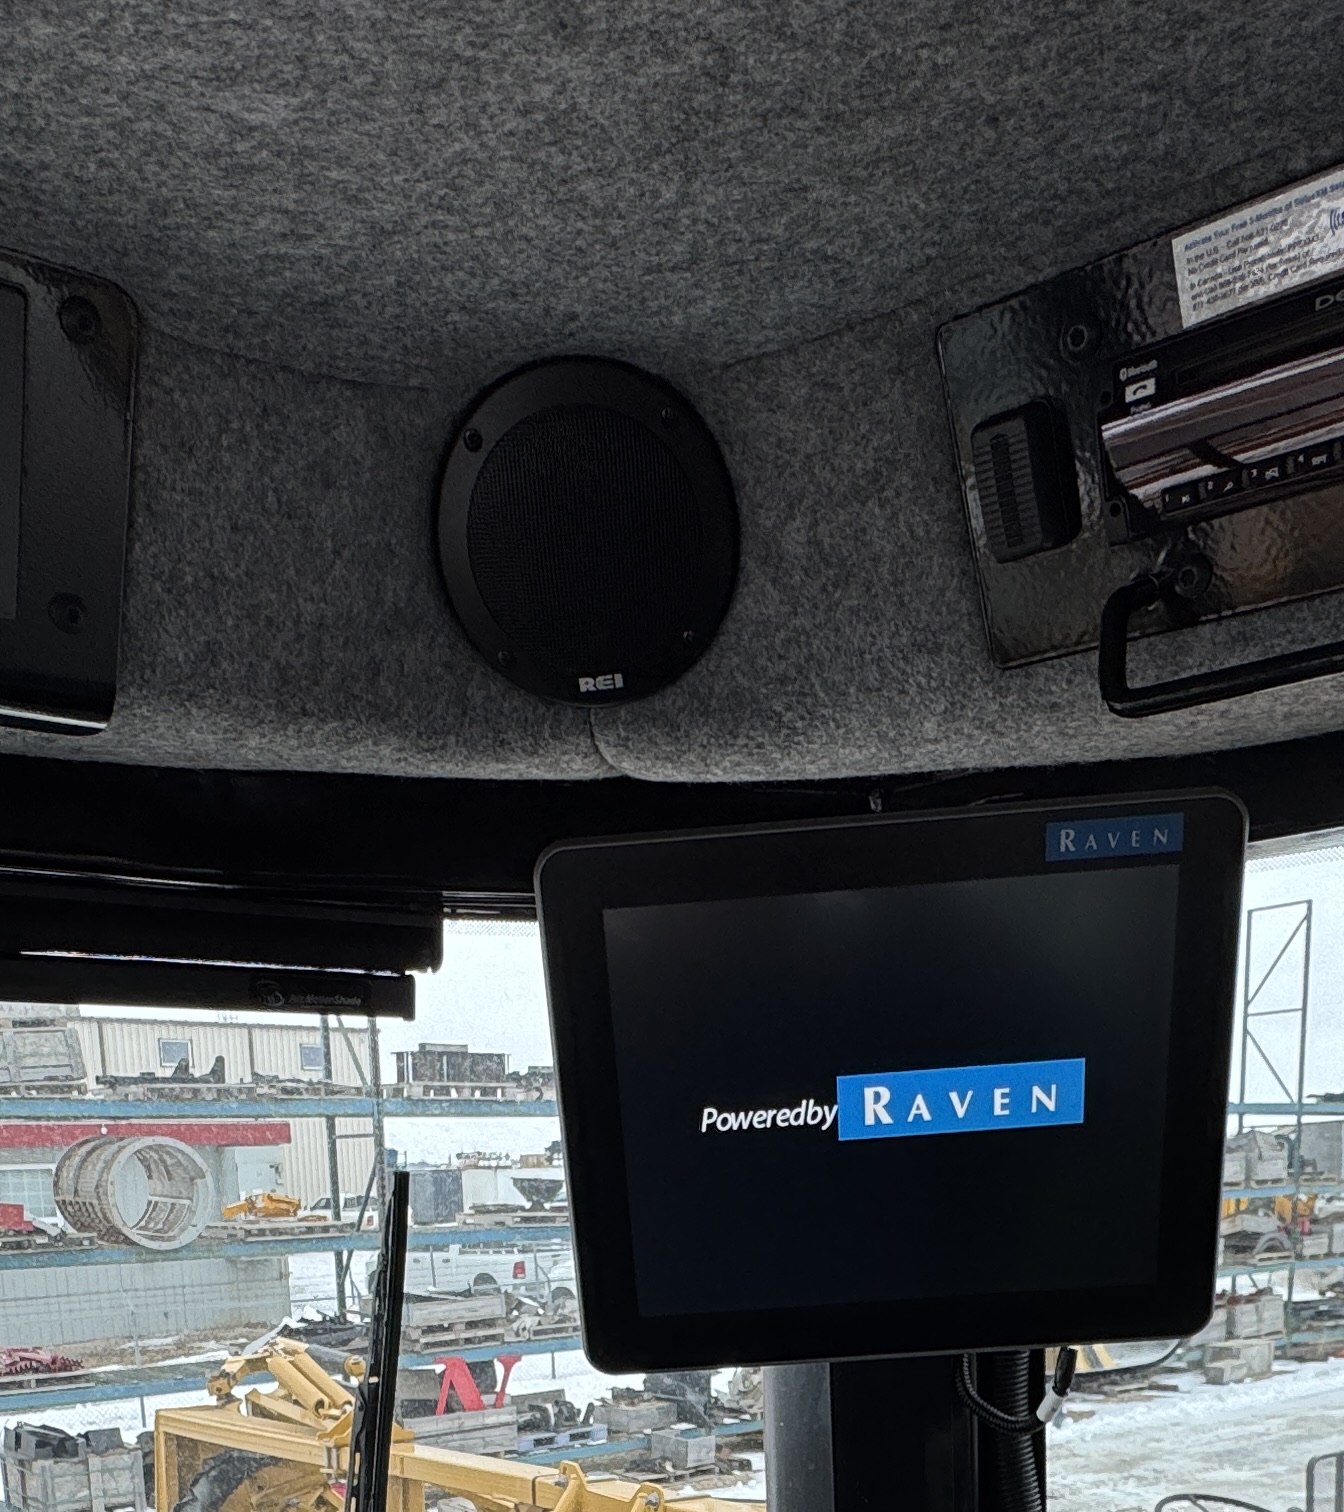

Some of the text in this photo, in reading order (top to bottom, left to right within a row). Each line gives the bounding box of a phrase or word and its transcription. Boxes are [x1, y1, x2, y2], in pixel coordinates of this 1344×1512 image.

[578, 672, 624, 693] REI
[1059, 828, 1169, 852] RAVEN
[700, 1083, 1058, 1133] Poweredby RAVEN
